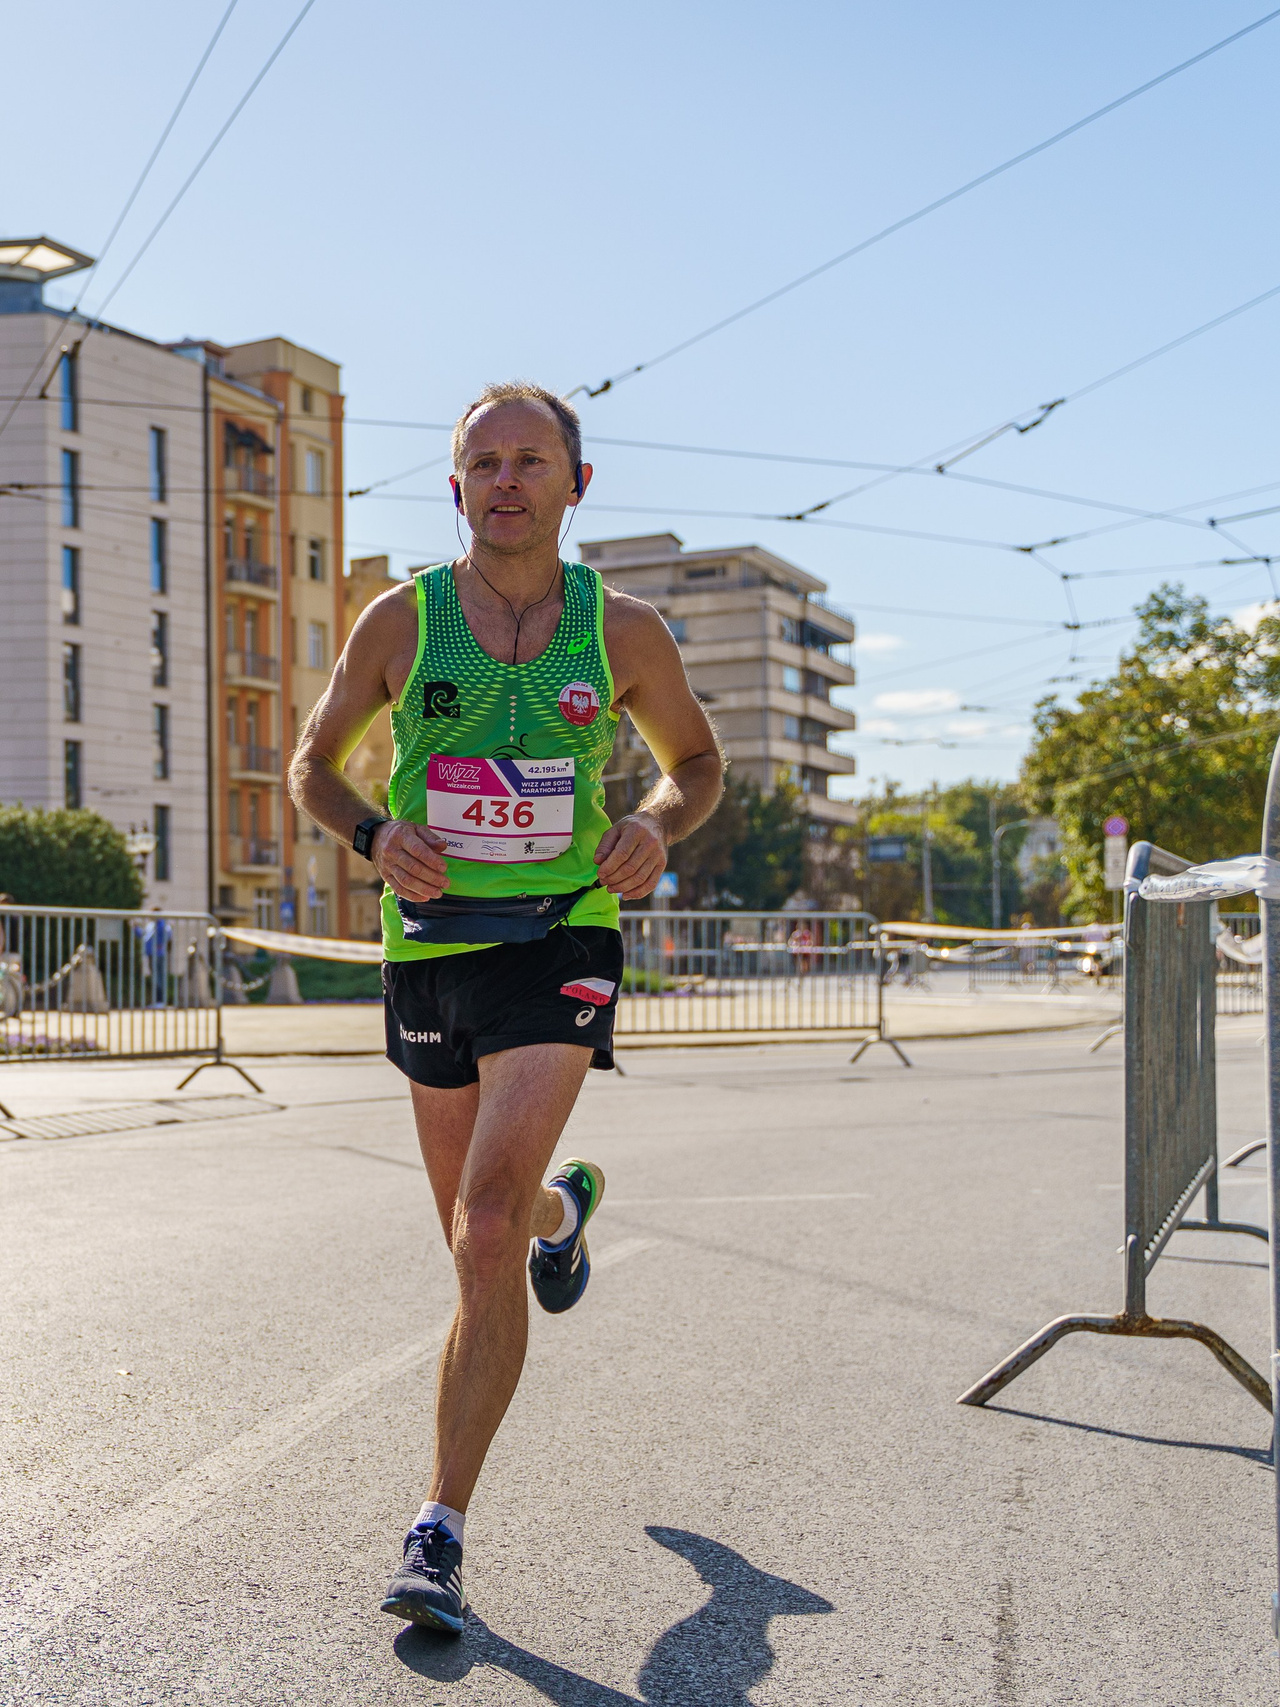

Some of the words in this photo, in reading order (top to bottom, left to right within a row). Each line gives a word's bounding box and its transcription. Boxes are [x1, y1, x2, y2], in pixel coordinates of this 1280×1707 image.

[528, 765, 556, 774] 42.195
[446, 782, 481, 790] wizzair.com
[552, 779, 572, 787] SOFIA
[462, 799, 535, 829] 436
[564, 985, 606, 1005] POLAND
